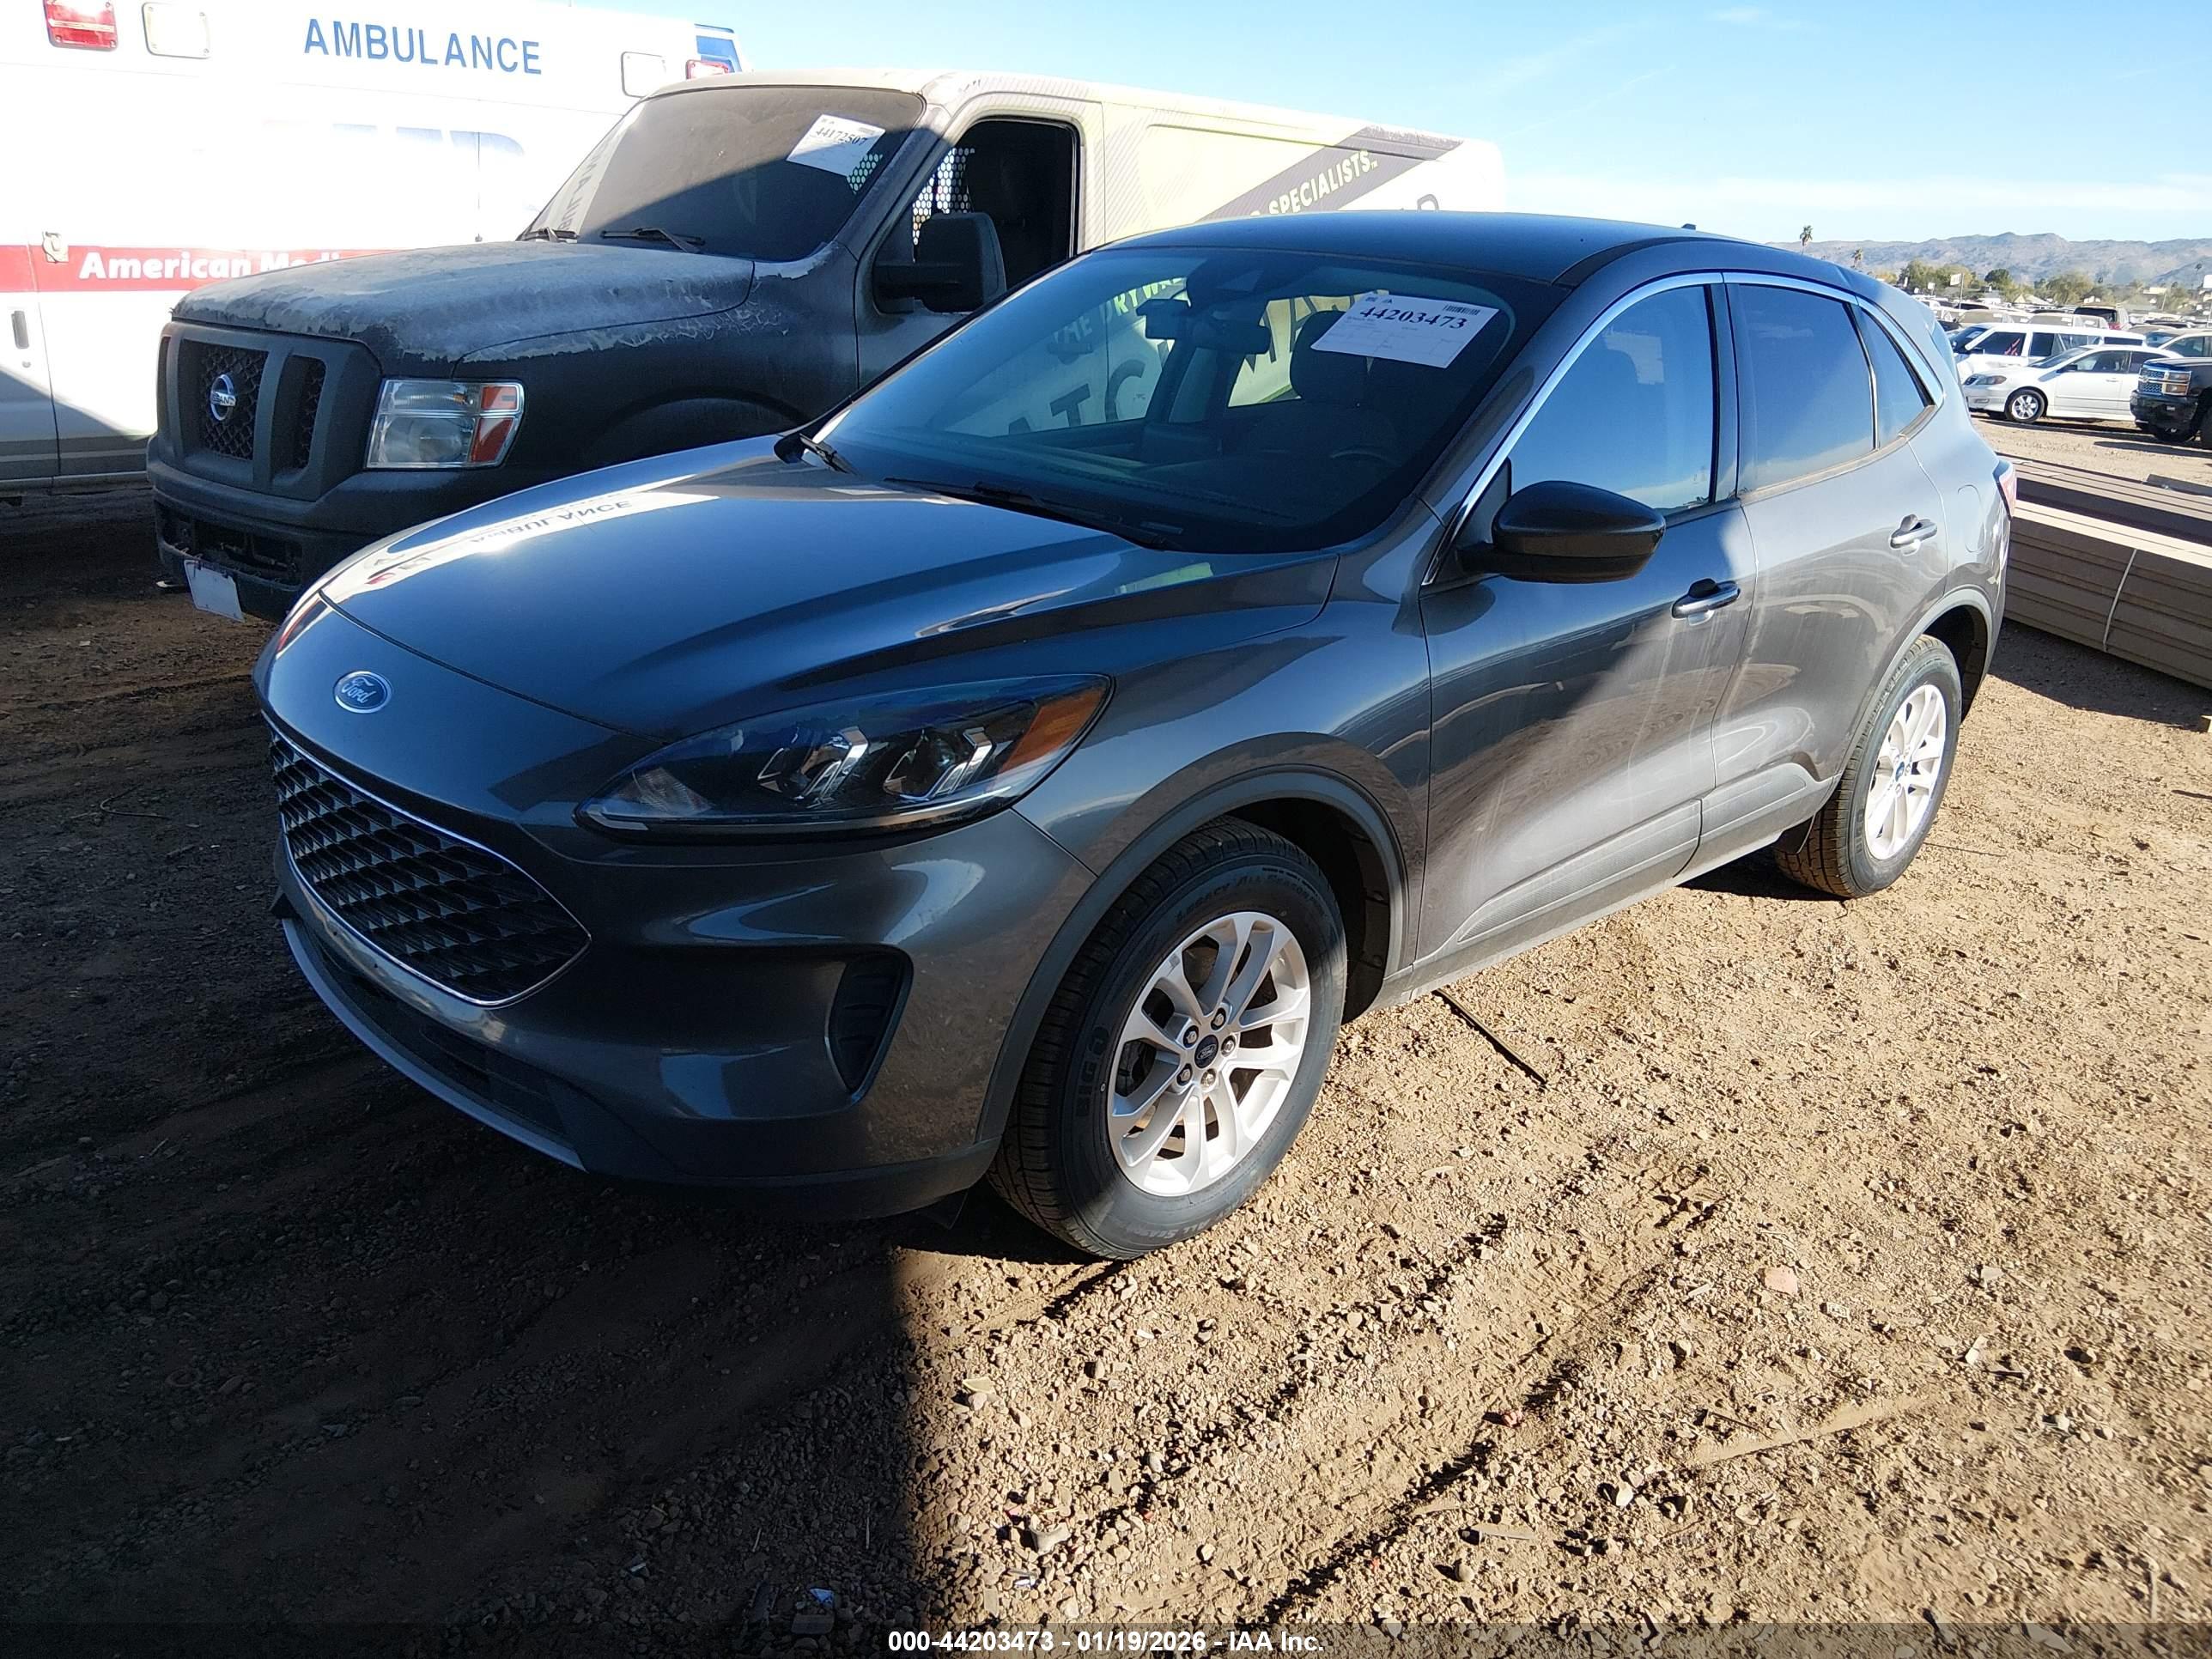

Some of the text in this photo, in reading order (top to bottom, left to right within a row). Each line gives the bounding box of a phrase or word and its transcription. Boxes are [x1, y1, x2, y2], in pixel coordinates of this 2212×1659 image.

[304, 18, 542, 75] AMBULANCE
[79, 251, 252, 280] American
[1359, 307, 1469, 330] 44203473
[341, 677, 377, 703] Ford
